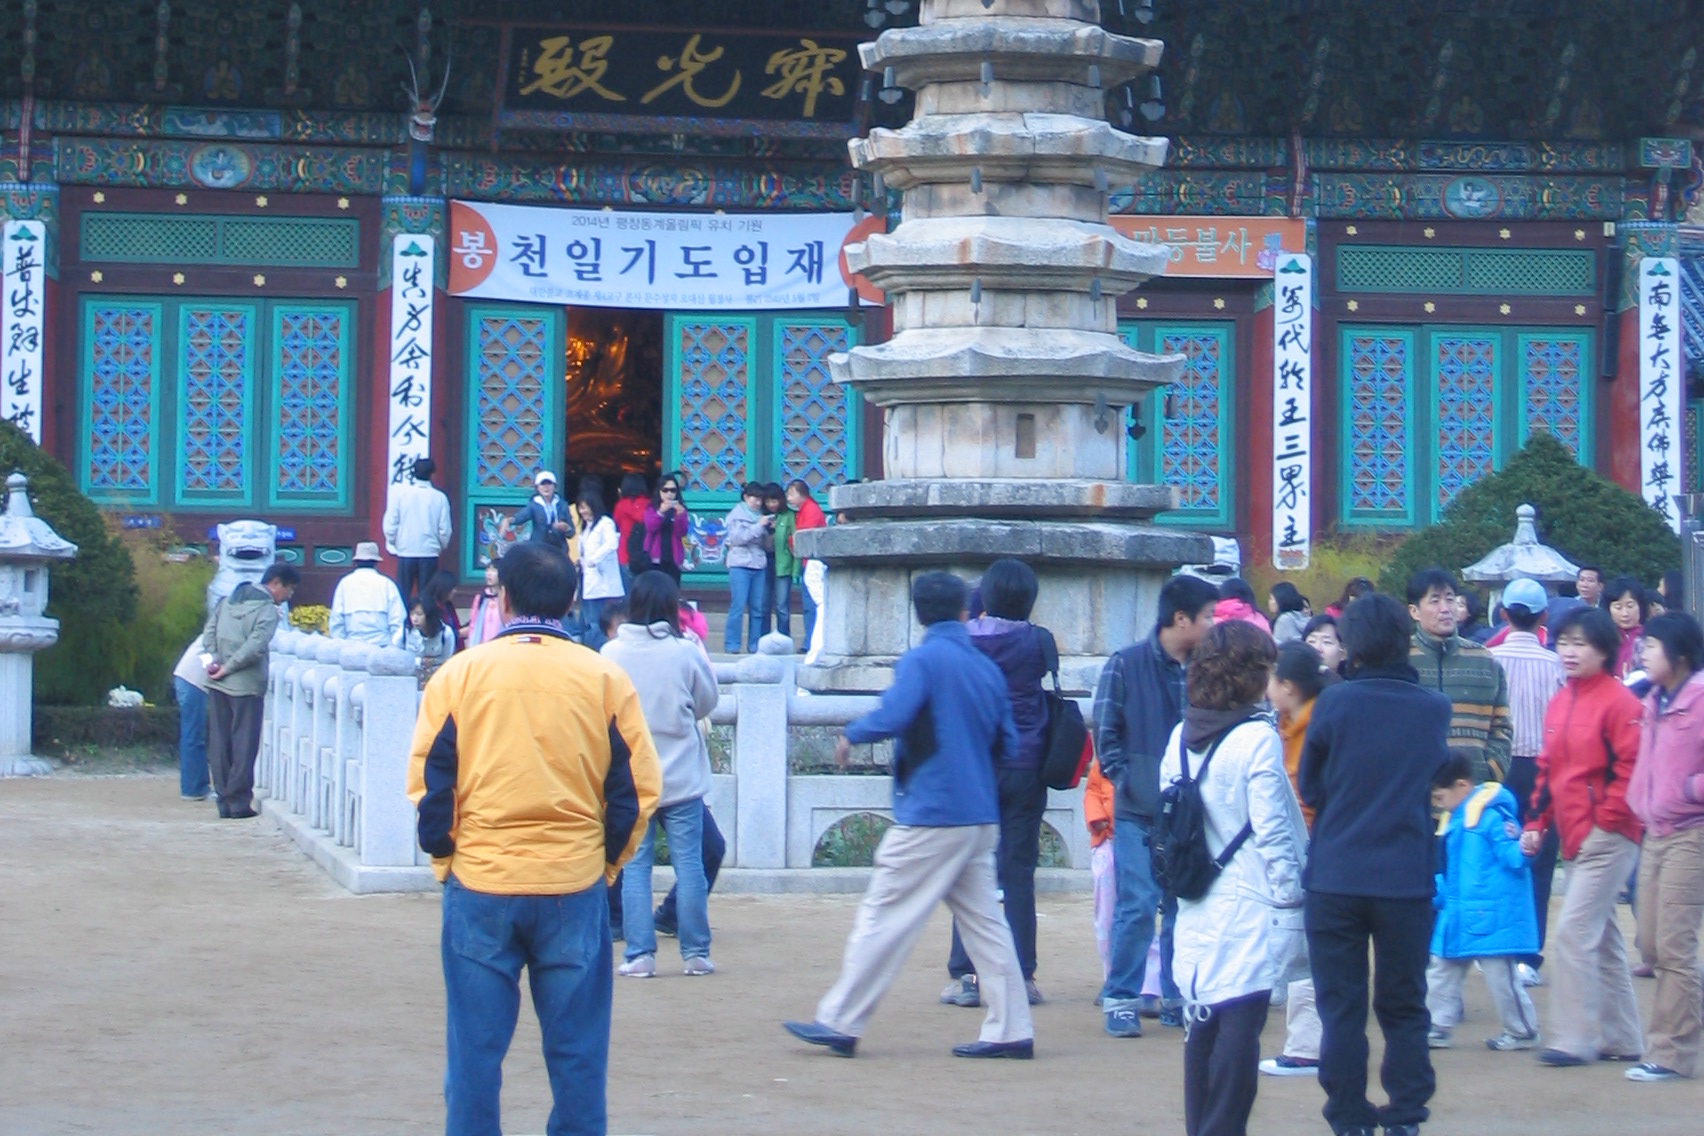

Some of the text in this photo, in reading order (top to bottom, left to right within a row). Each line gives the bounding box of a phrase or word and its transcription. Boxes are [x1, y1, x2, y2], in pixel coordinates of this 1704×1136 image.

[571, 215, 763, 233] 2014년 평창동계올림픽 유치 기원
[452, 230, 493, 269] 봉
